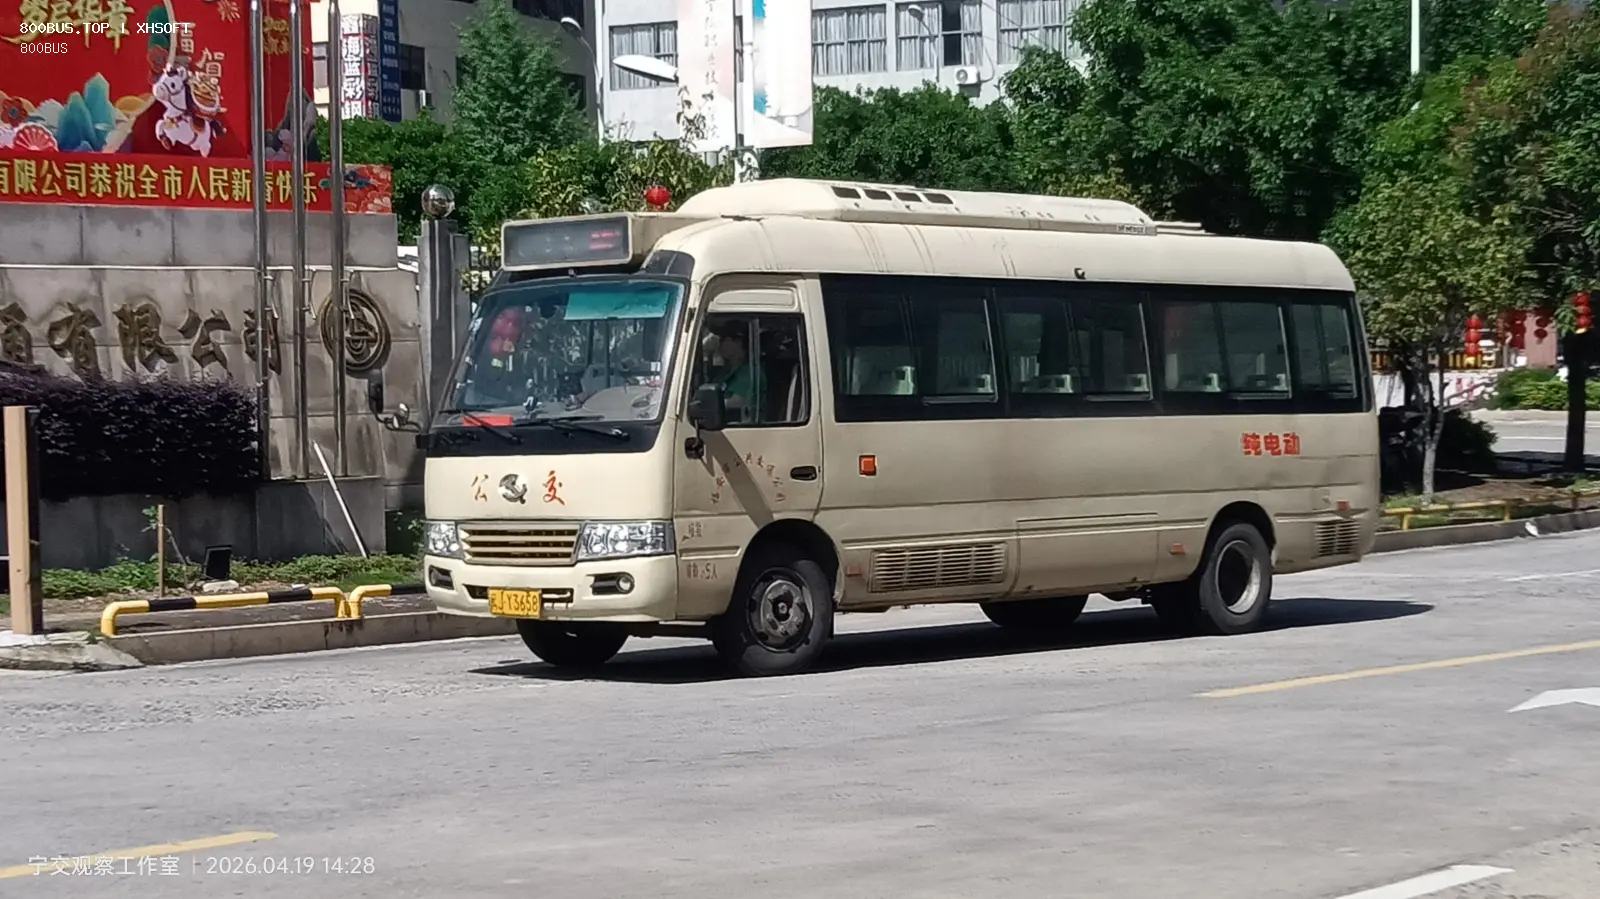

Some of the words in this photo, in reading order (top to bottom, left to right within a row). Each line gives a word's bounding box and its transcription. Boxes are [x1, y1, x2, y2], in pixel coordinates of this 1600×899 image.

[1242, 432, 1300, 456] 纯电动
[471, 474, 489, 502] 公
[542, 470, 565, 505] 交
